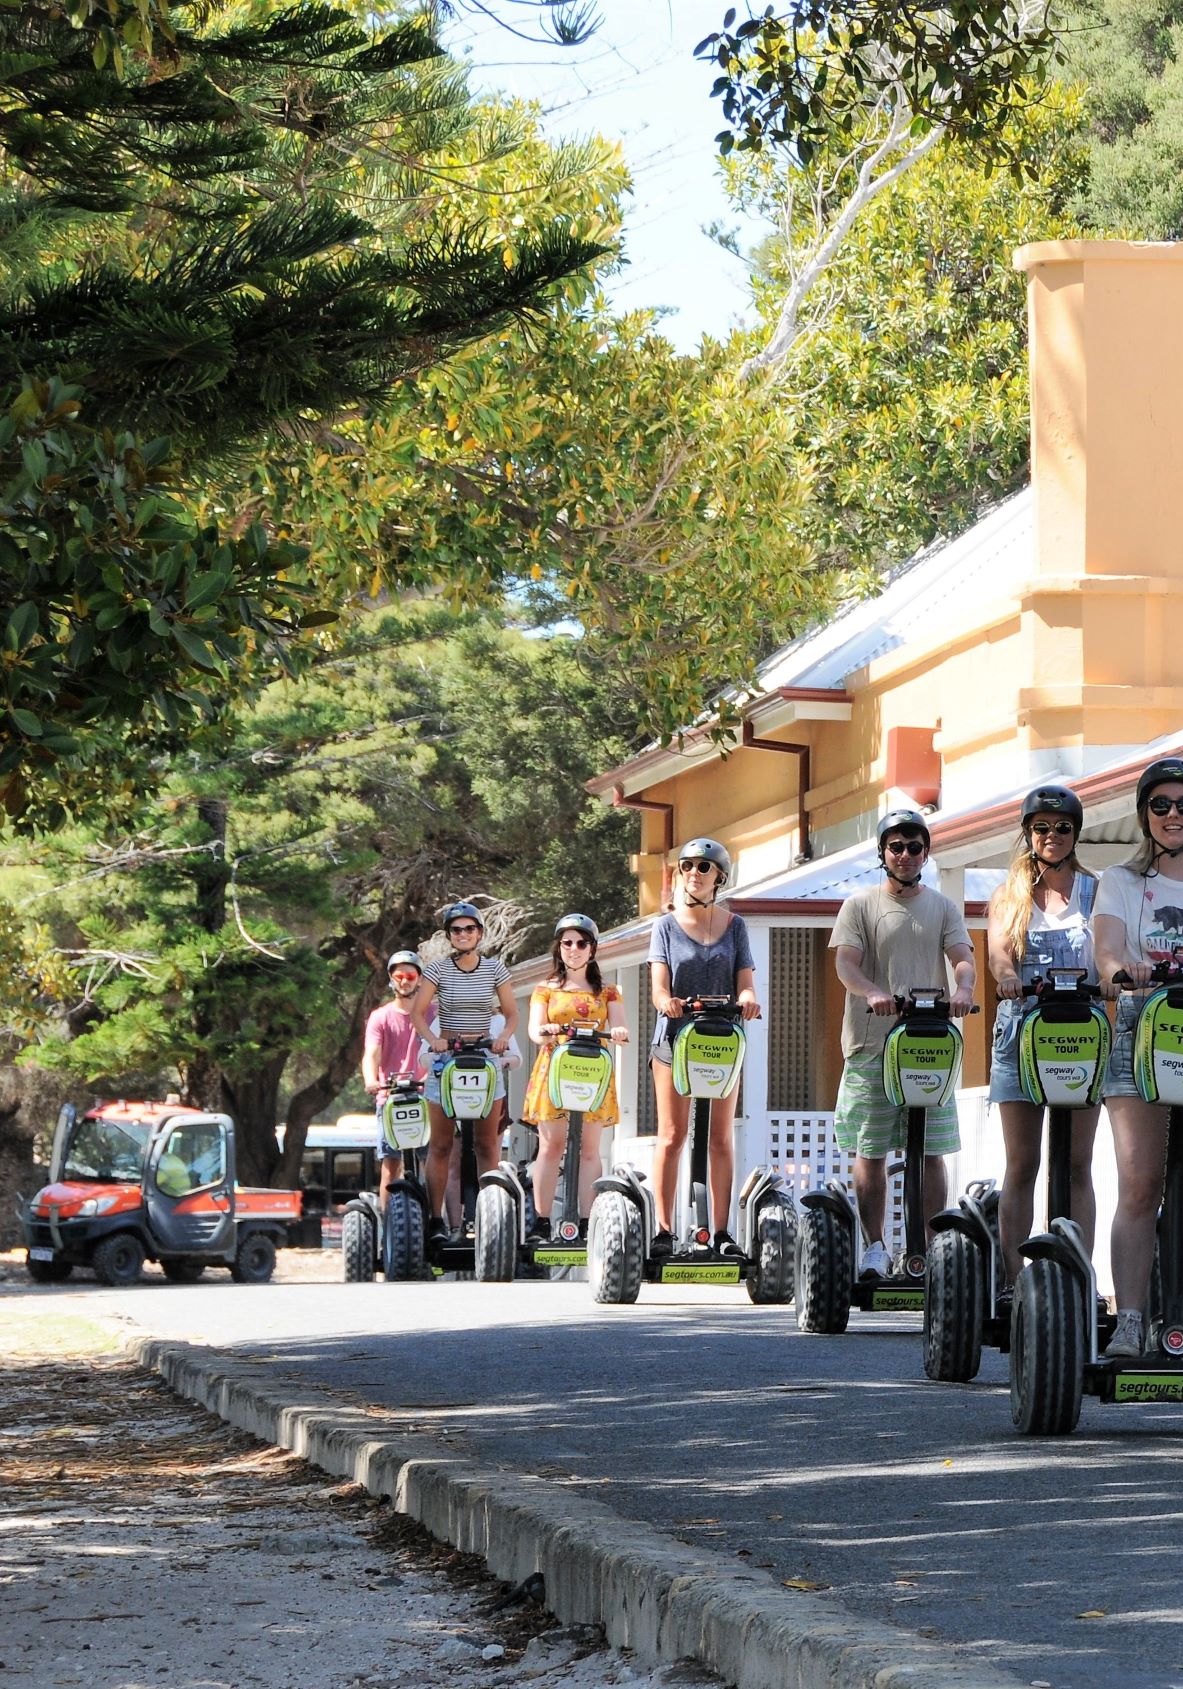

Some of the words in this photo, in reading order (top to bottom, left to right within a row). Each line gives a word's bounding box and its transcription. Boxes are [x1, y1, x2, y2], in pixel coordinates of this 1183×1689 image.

[1038, 1036, 1097, 1044] SEGWAY
[690, 1043, 735, 1052] SEGWAY
[1054, 1045, 1079, 1053] TOUR
[563, 1064, 602, 1072] SEGWAY
[1045, 1067, 1075, 1075] segway
[458, 1075, 479, 1086] 11
[395, 1109, 420, 1120] 09
[664, 1269, 736, 1279] segtours.com.au
